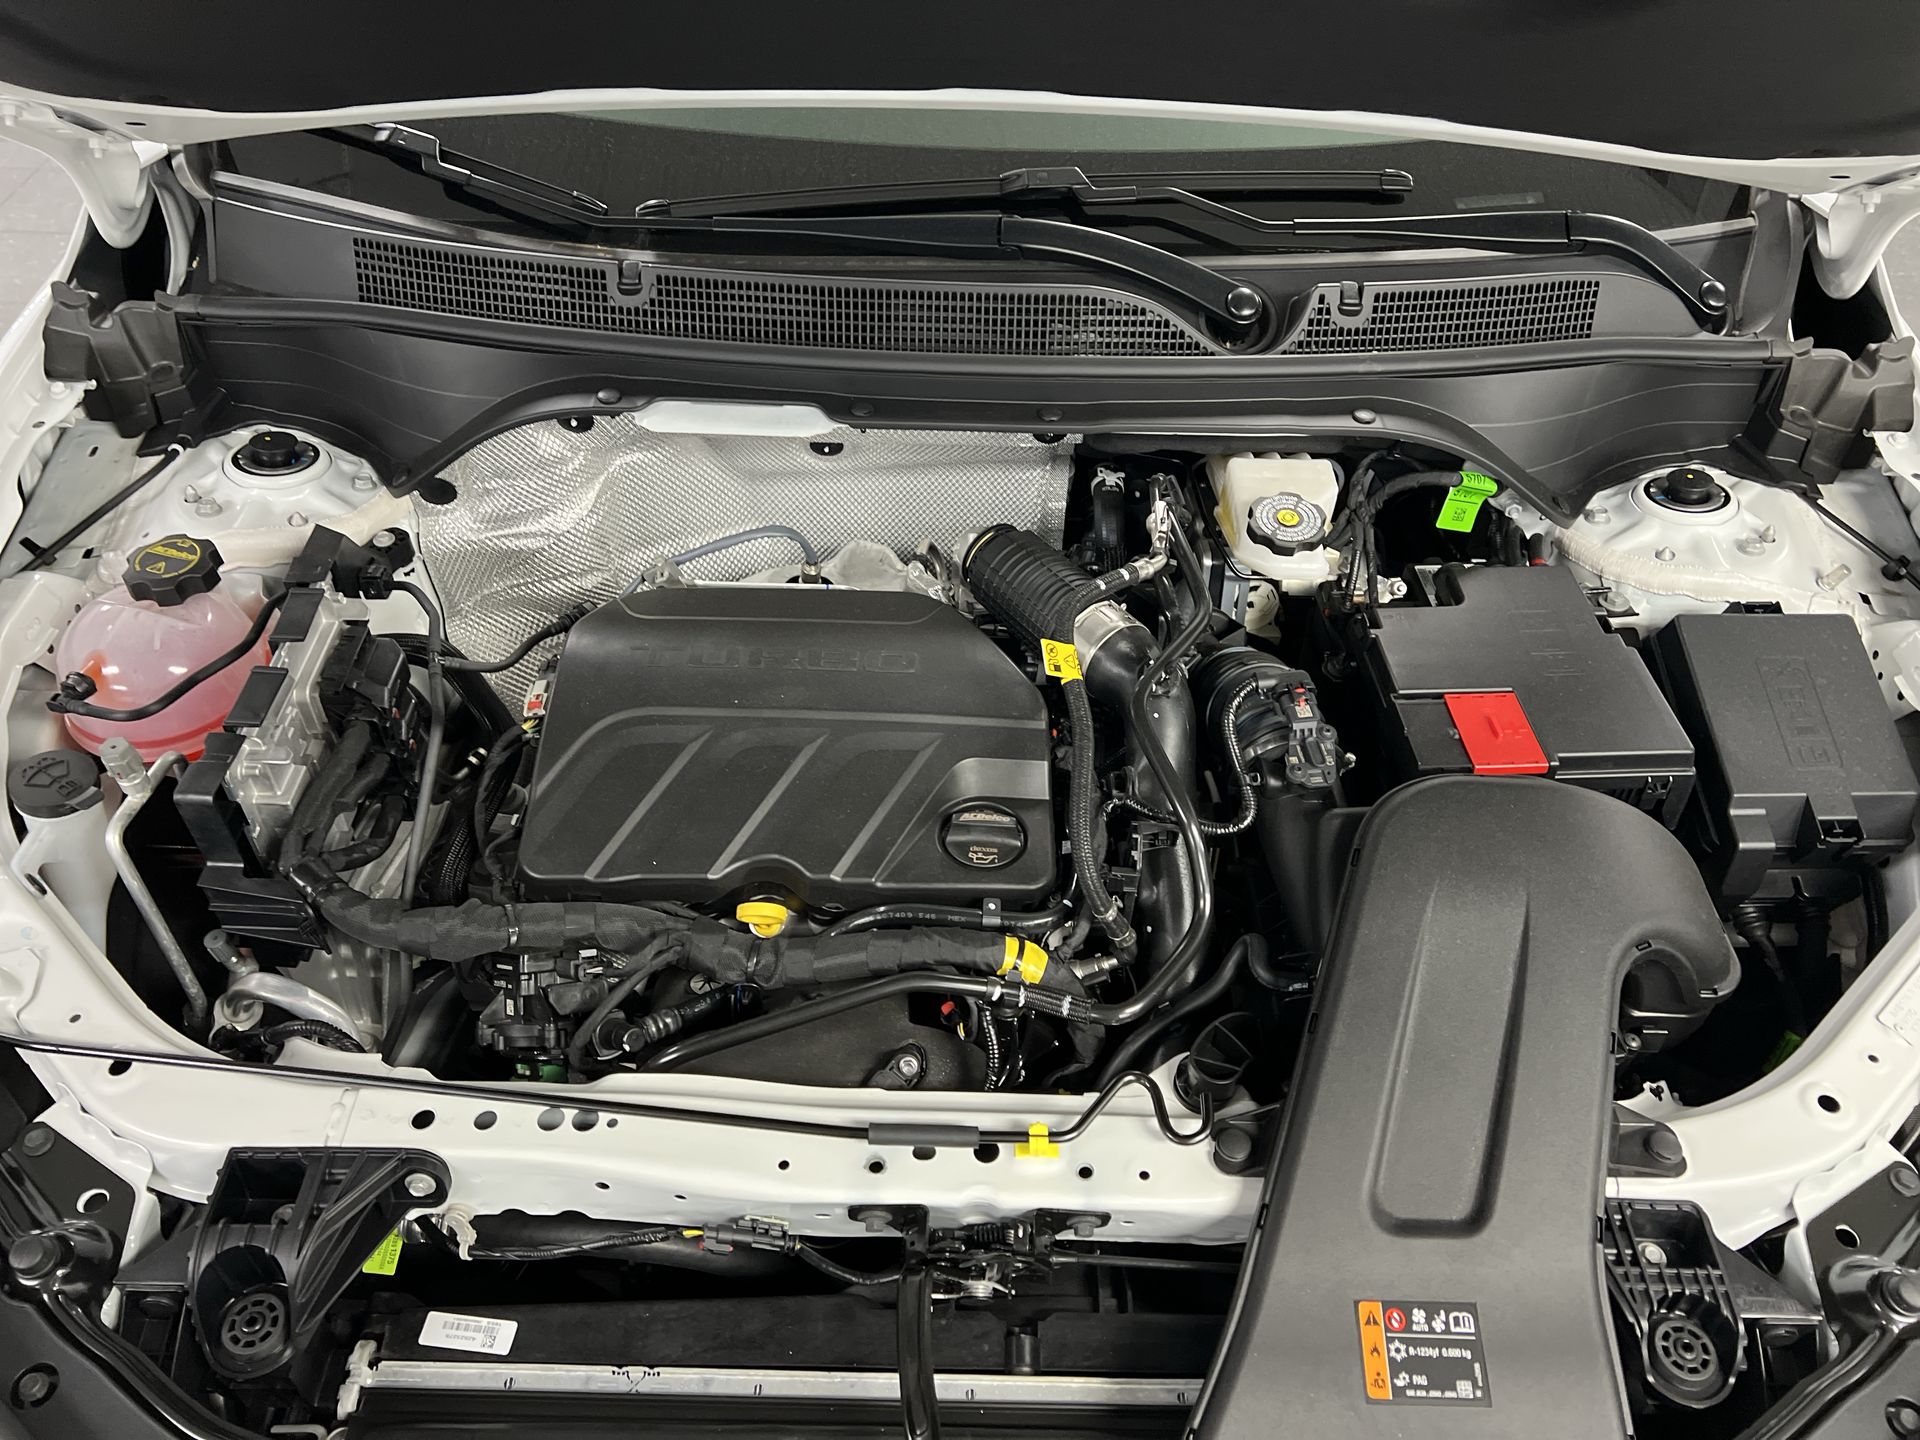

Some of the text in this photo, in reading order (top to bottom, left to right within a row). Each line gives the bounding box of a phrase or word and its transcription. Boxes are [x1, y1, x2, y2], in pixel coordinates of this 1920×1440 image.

[1465, 473, 1487, 485] 5707
[630, 645, 919, 673] TURBO
[959, 812, 1011, 822] ACDelco
[969, 845, 998, 853] dexos
[1412, 1323, 1429, 1332] AUTO
[1462, 1348, 1472, 1360] kg
